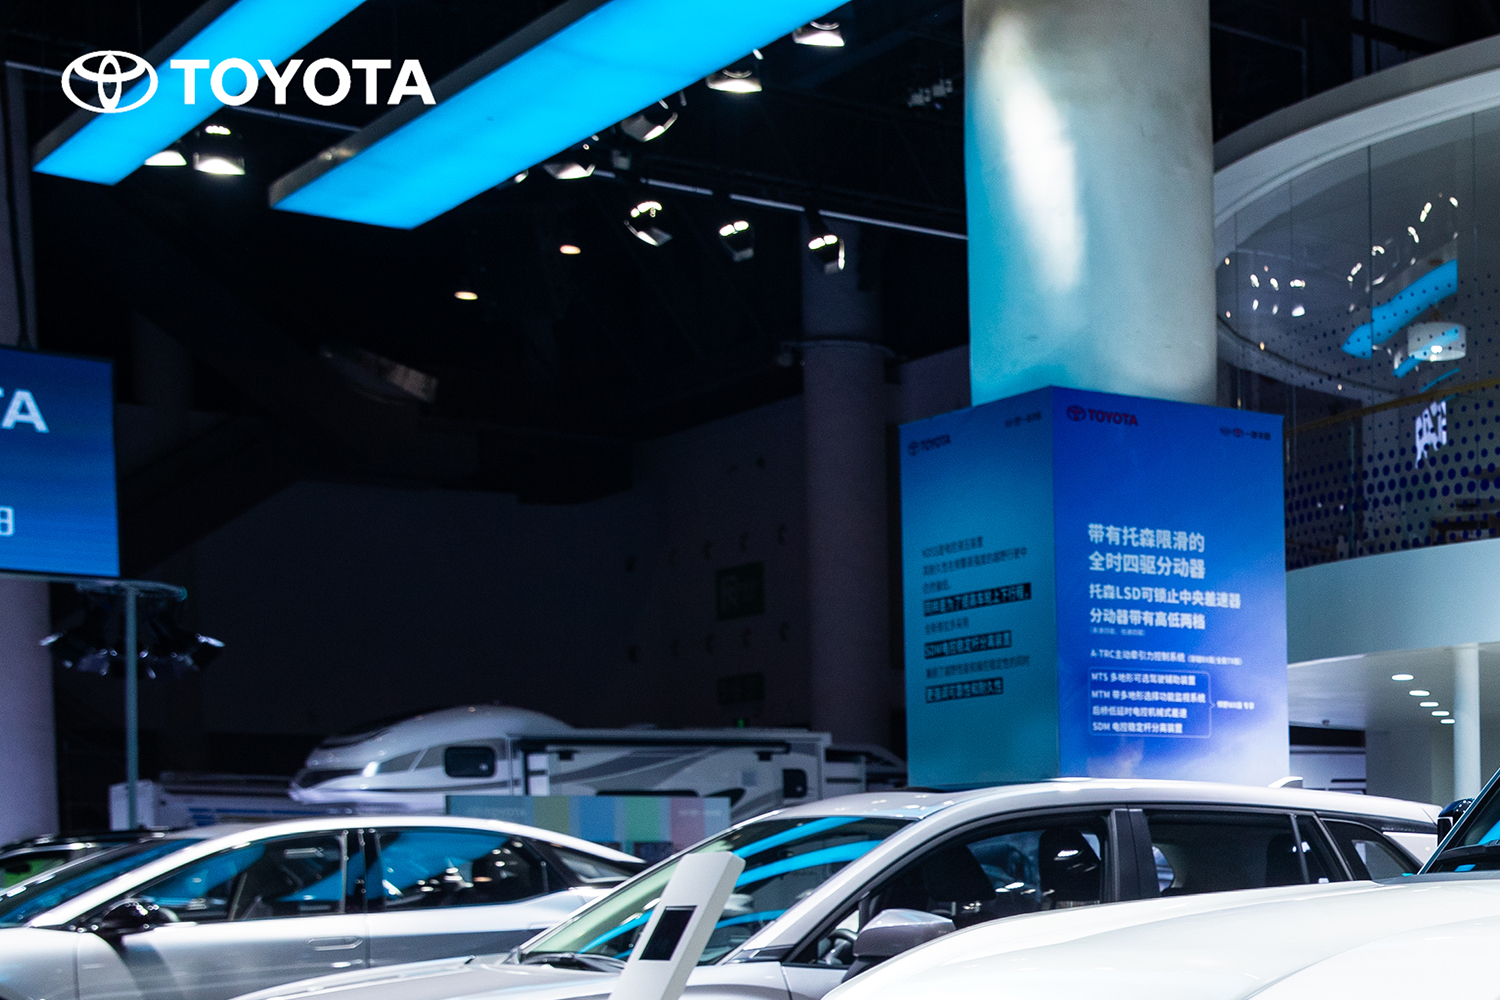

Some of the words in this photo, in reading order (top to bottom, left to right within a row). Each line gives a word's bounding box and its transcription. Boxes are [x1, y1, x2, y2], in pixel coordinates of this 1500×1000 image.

[0, 386, 50, 434] A
[1088, 409, 1139, 428] TOYOTA
[1088, 523, 1206, 553] 带有托森限滑的
[1088, 551, 1206, 579] 全时四驱分动器
[1089, 583, 1241, 609] 托森LSD可锁止中央差速器
[1089, 608, 1206, 630] 分动器带有高低两档
